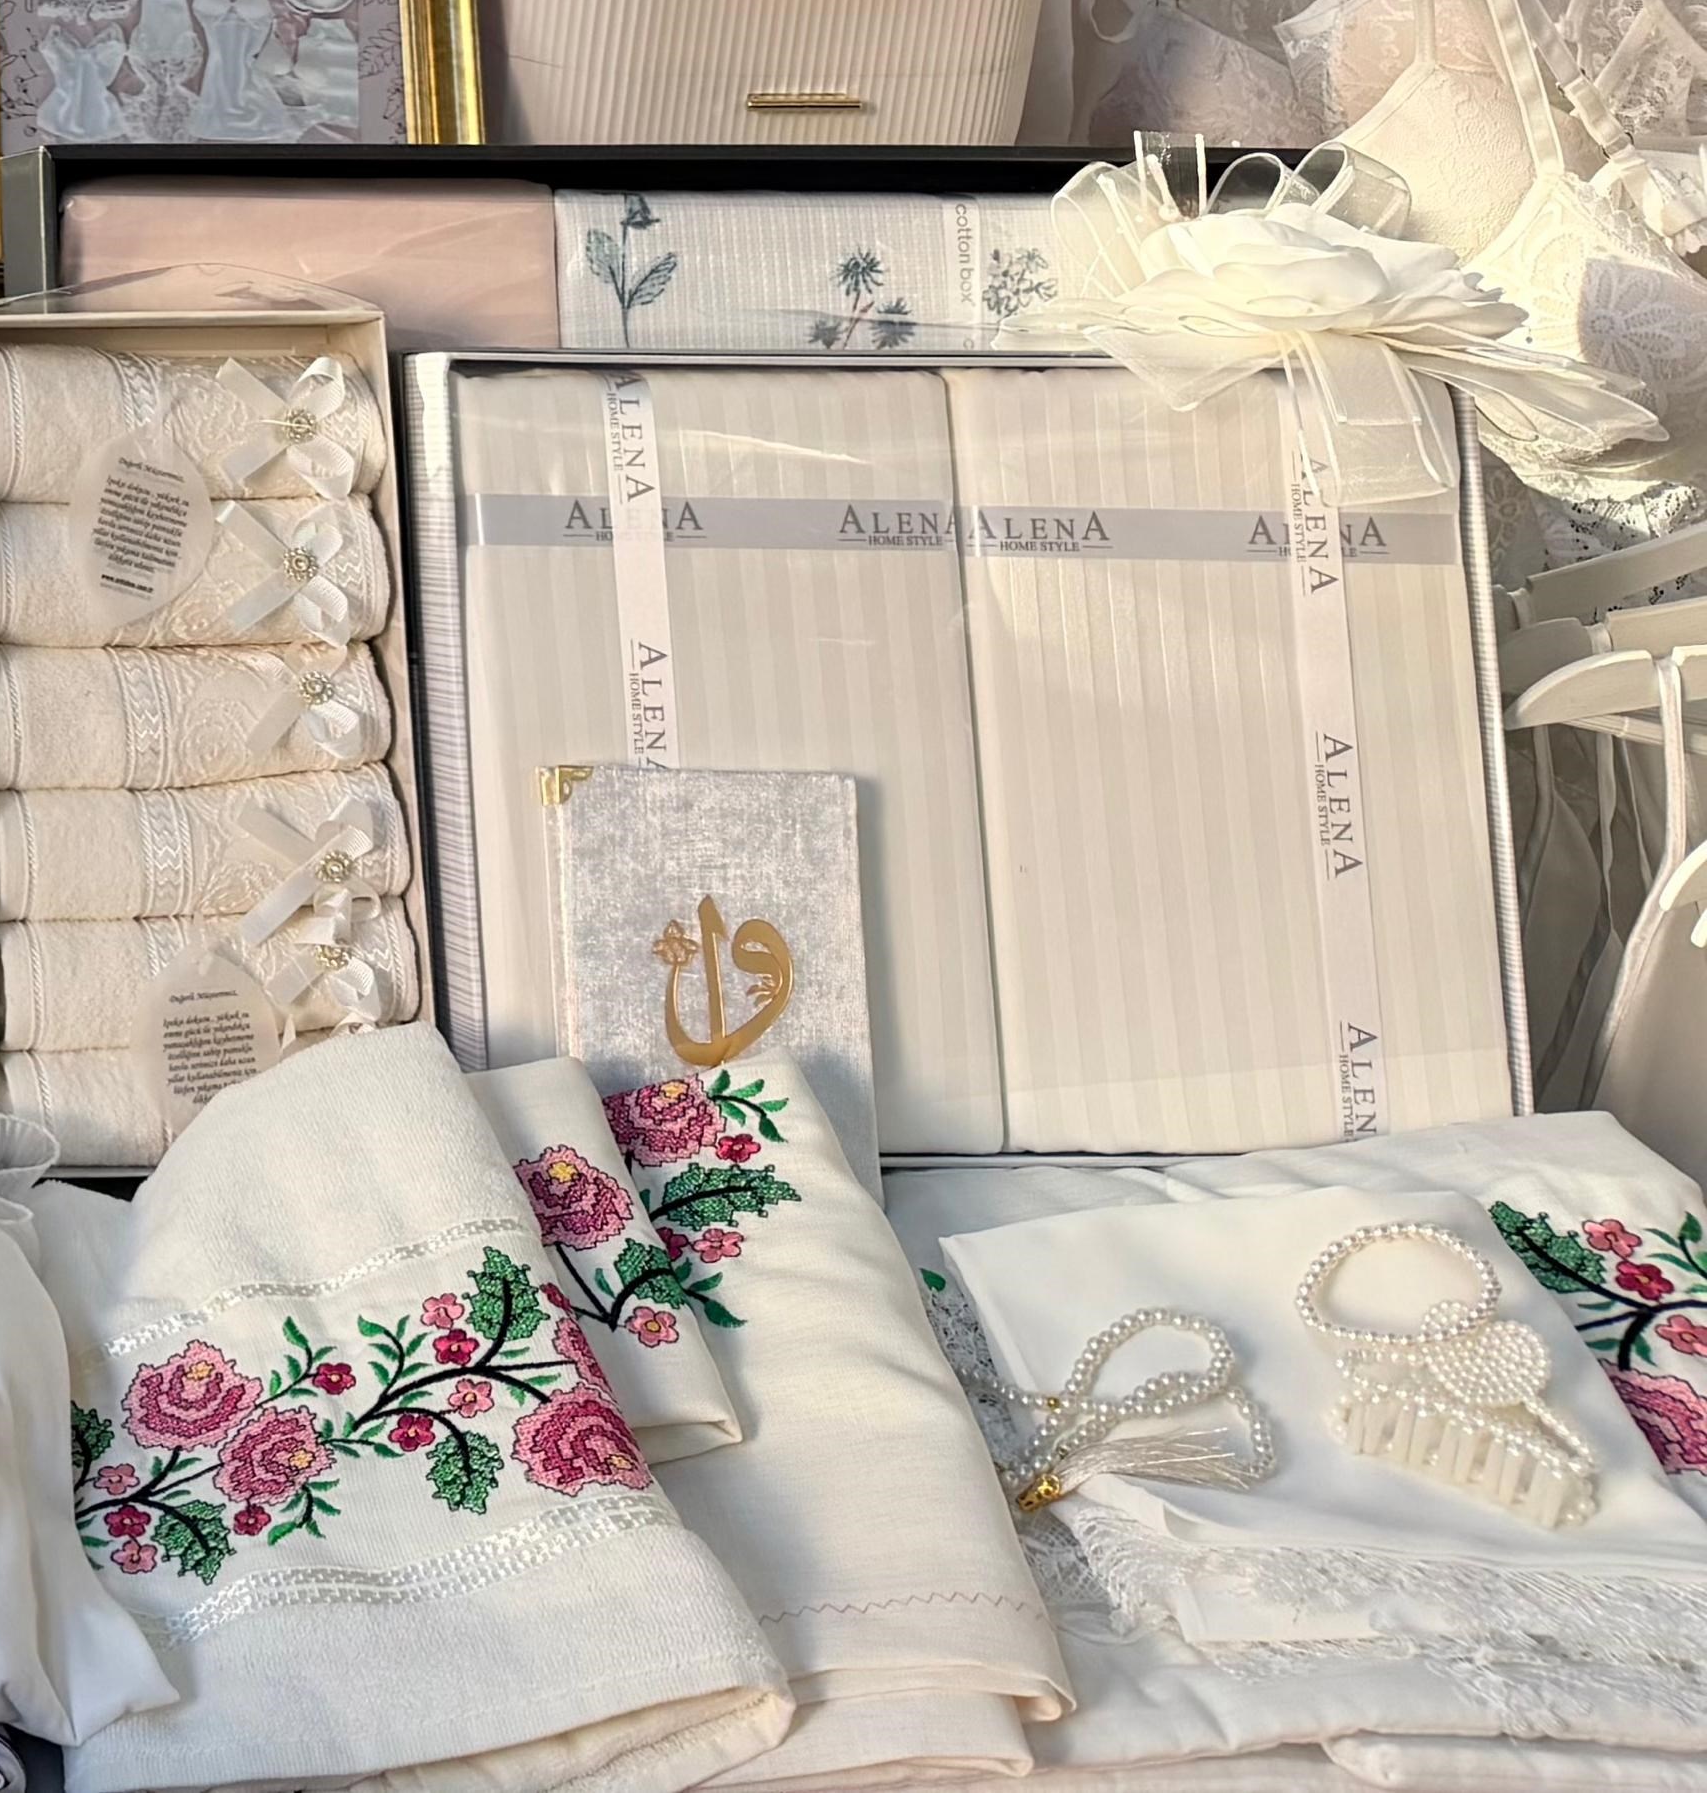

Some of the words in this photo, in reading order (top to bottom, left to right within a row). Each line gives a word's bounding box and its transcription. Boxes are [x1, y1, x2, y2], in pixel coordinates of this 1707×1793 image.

[955, 203, 973, 264] cotton
[959, 267, 975, 304] box
[607, 392, 620, 430] HOME
[611, 432, 624, 472] STYLE
[615, 371, 655, 502] ALENA
[565, 499, 704, 531] ALA
[1291, 483, 1303, 521] HOME
[868, 535, 905, 546] HOME
[906, 536, 943, 547] STYLE
[968, 510, 1110, 541] ALENA
[1248, 515, 1386, 547] ANA
[1294, 522, 1306, 563] STYLE
[1000, 541, 1037, 552] HOME
[1040, 542, 1080, 553] STYLE
[629, 672, 642, 711] HOME
[632, 713, 644, 755] STYLE
[1315, 764, 1327, 802] HOME
[1323, 733, 1363, 878] ALENA
[1318, 805, 1331, 847] STYLE
[1339, 1054, 1351, 1093] HOME
[1348, 1022, 1378, 1134] ALEN
[1342, 1096, 1355, 1138] STYLE
